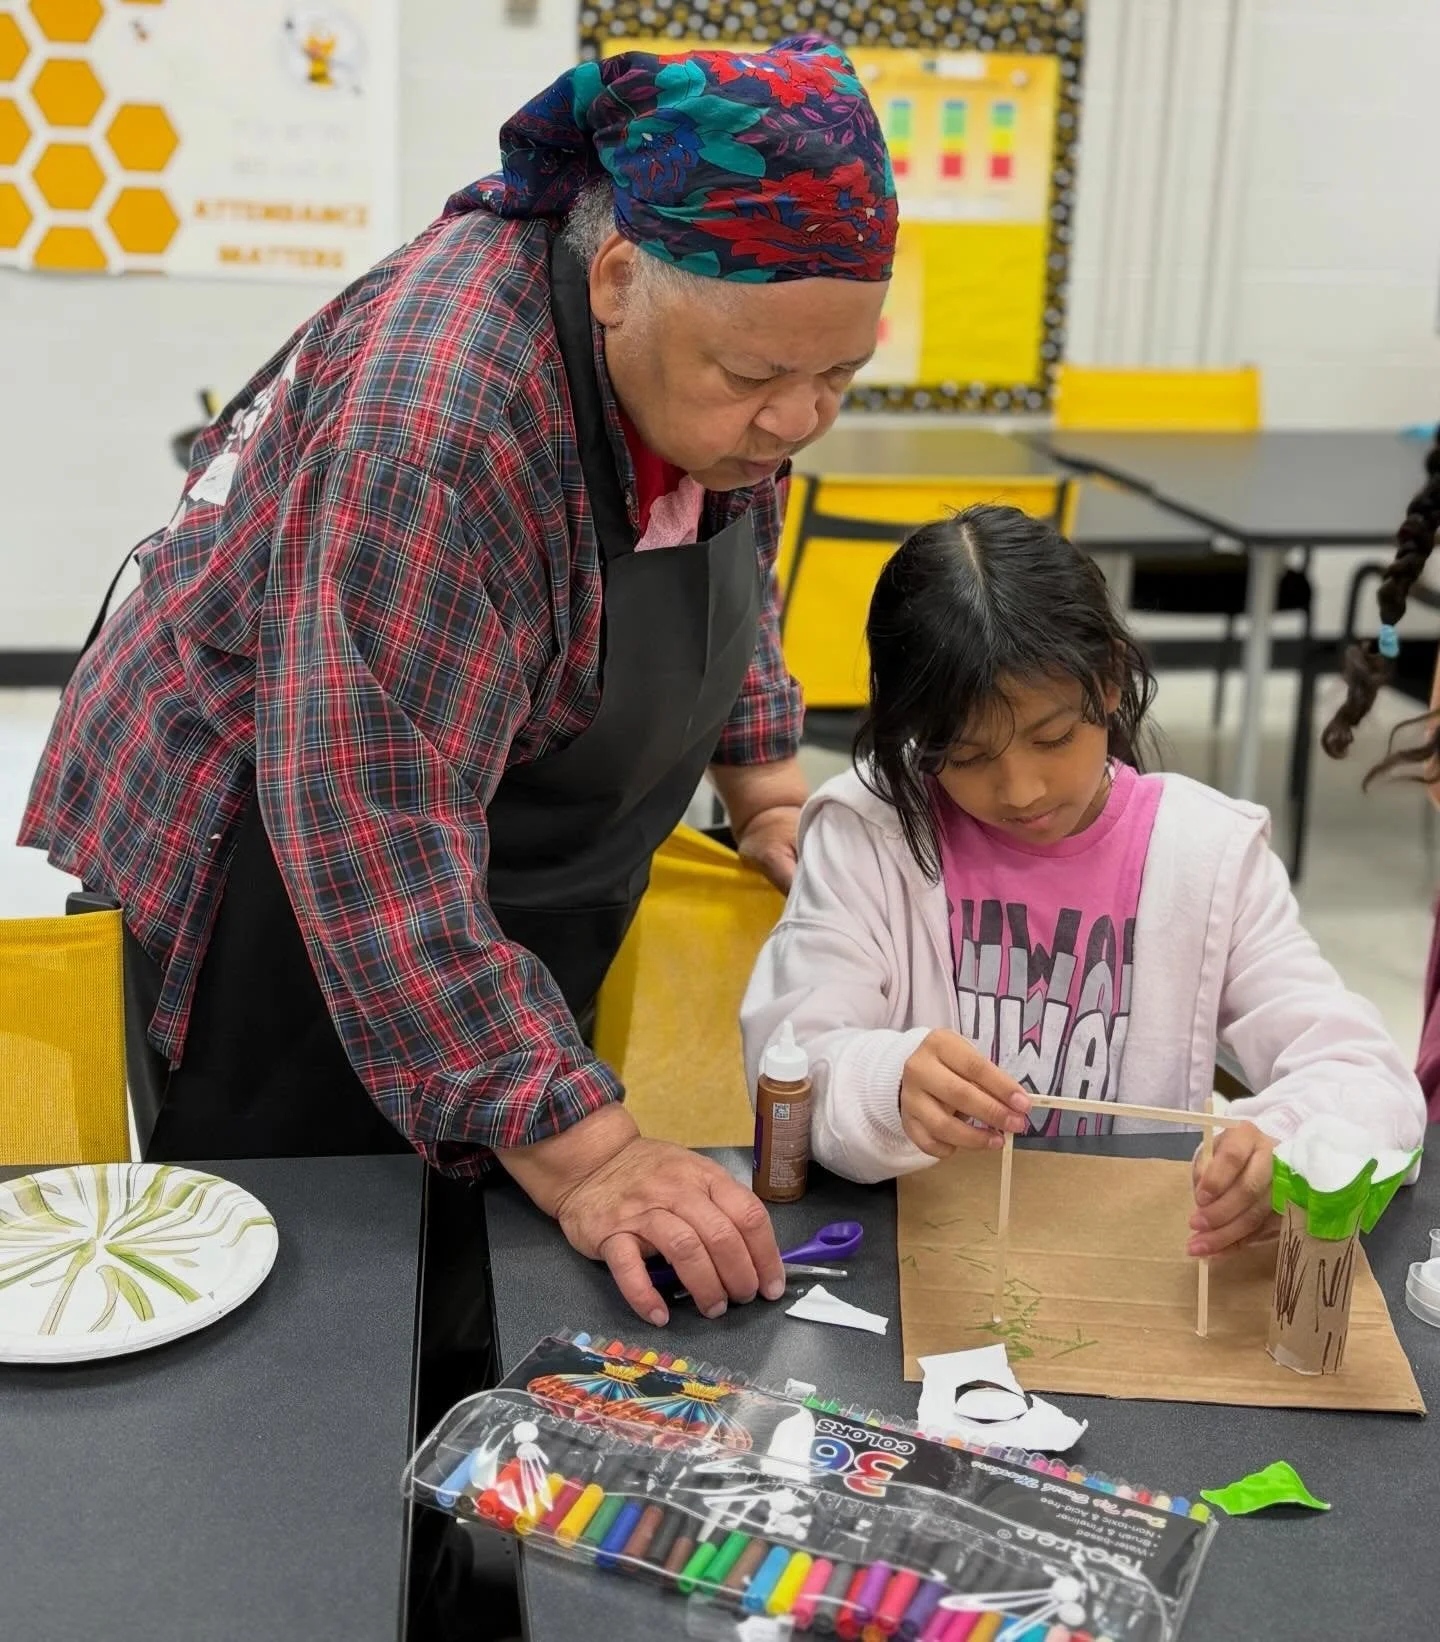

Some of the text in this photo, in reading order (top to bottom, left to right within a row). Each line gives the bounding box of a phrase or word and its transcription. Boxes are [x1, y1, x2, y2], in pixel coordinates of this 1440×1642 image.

[194, 199, 368, 228] ATTENDANCE
[218, 244, 343, 268] MATTERS
[815, 1418, 916, 1455] COLORS
[809, 1436, 909, 1498] 36
[1040, 1496, 1090, 1517] Acid-free
[1102, 1515, 1156, 1538] Non-toxic
